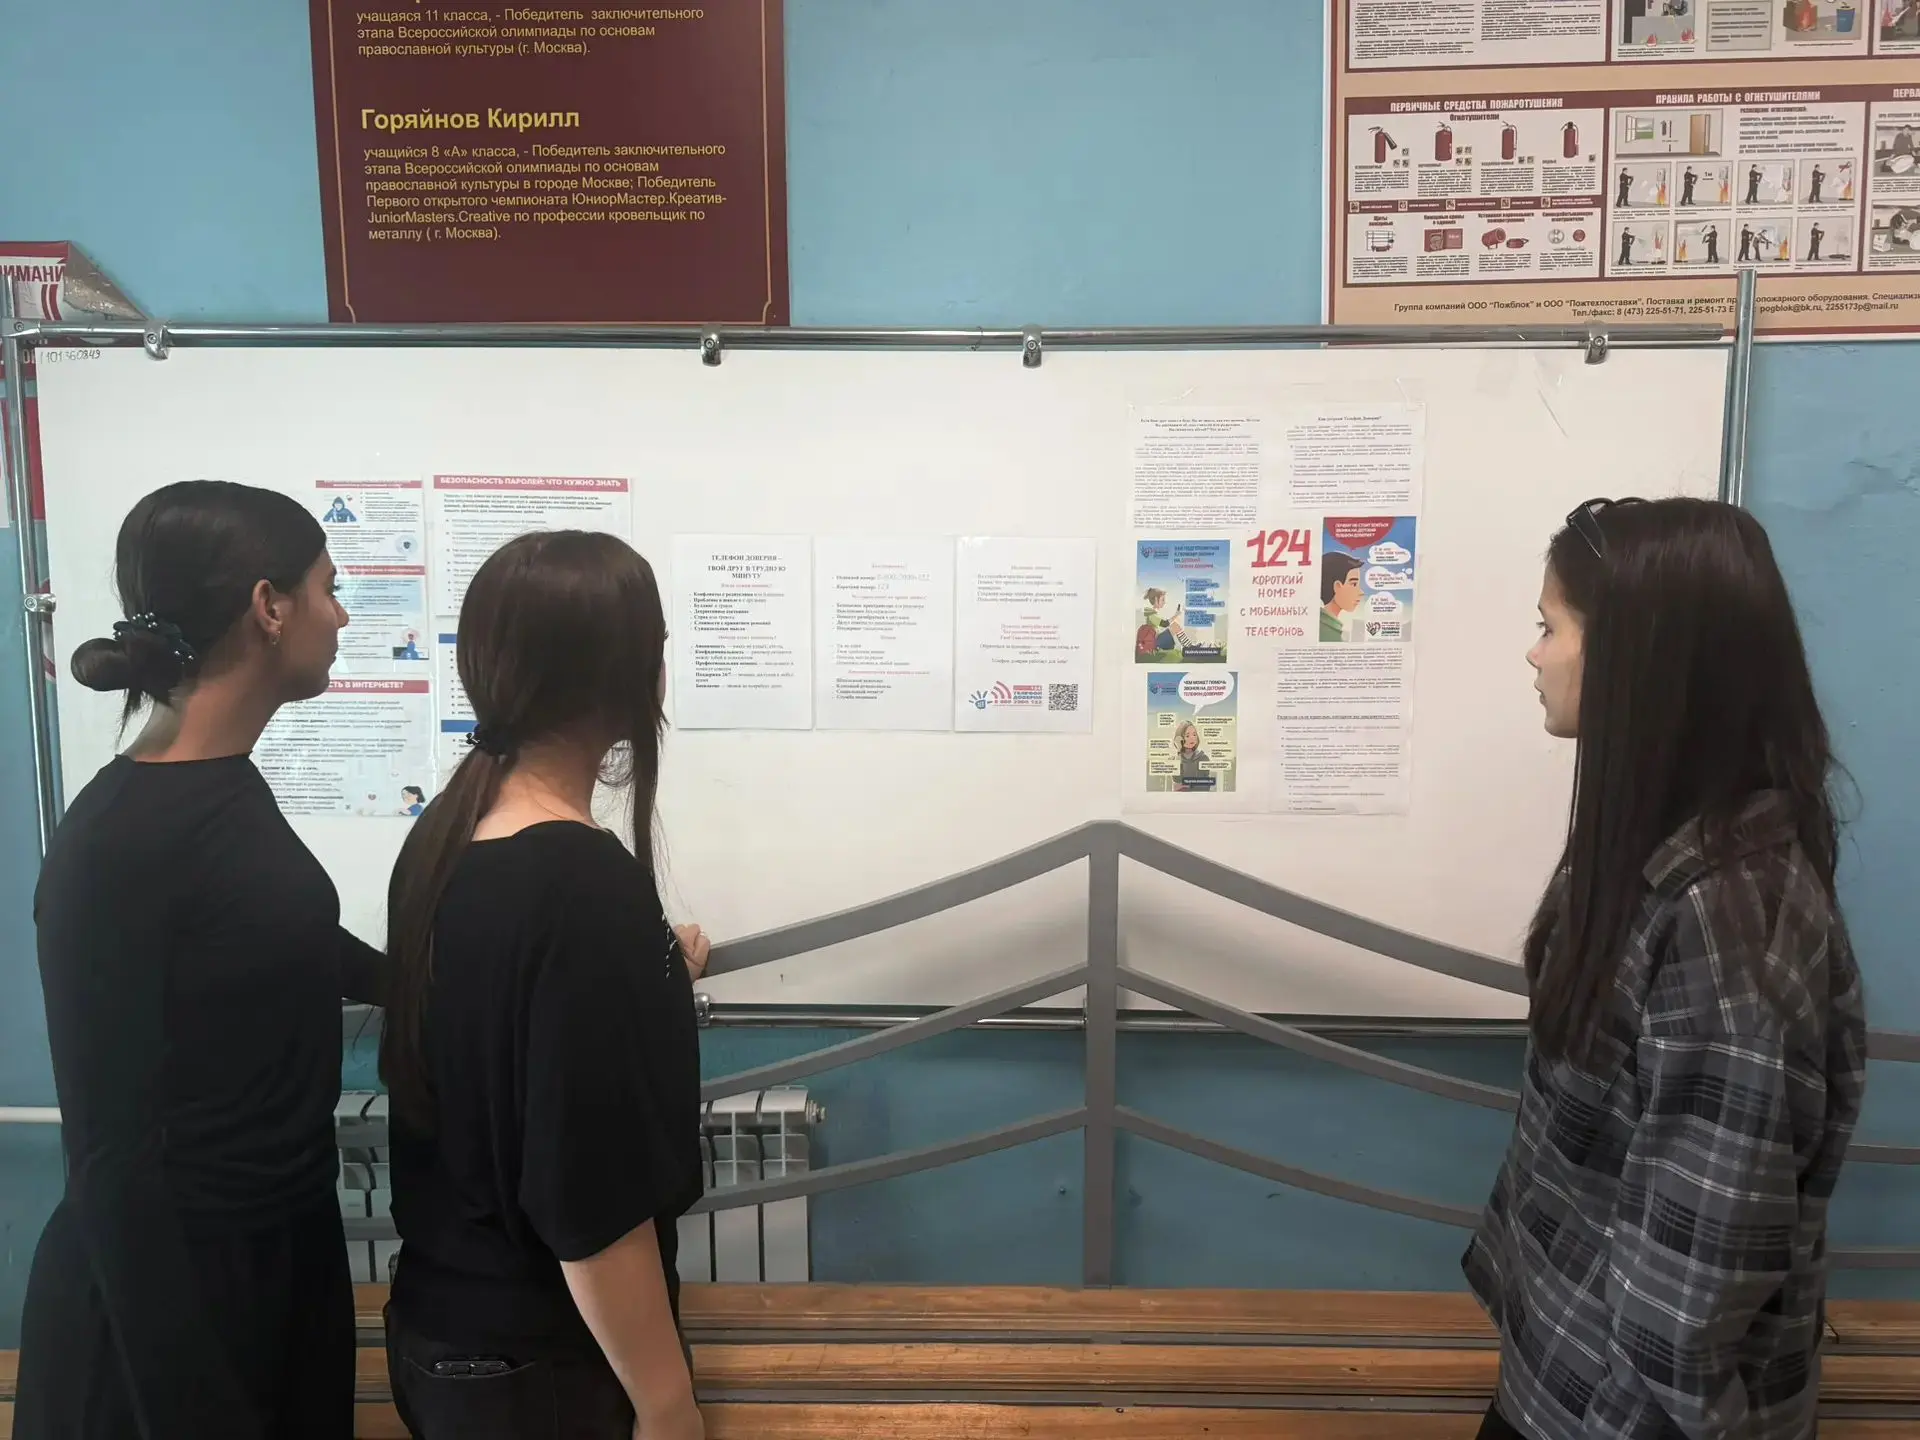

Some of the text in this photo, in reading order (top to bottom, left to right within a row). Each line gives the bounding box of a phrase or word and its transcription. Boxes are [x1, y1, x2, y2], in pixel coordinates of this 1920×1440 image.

[357, 11, 421, 24] учащаяся
[425, 9, 439, 21] 11
[444, 11, 492, 23] класса,
[505, 8, 584, 22] Победитель
[591, 8, 704, 20] заключительного
[357, 25, 655, 40] этапа Всероссийской олимпиады по основам
[358, 41, 591, 57] православной культуры (г. Москва).
[1390, 97, 1563, 113] ПЕРВИЧНЫЕ СРЕДСТВА ПОЖАРОТУШЕНИЯ
[1656, 90, 1821, 105] ПРАВИЛА РАБОТЫ С ОГНЕТУШИТЕЛЯМИ
[361, 107, 580, 134] Горяйнов Кирилл
[1450, 112, 1500, 122] Огнетушители
[364, 146, 428, 161] учащийся
[431, 145, 440, 157] 8
[443, 145, 467, 157] «А»
[472, 146, 520, 159] класса,
[532, 144, 610, 158] Победитель
[614, 144, 726, 156] заключительного
[364, 161, 659, 177] этапа Всероссийской олимпиады по основам
[366, 175, 716, 193] православной культуры в городе Москве; Победитель
[367, 192, 727, 209] Первого открытого чемпионата ЮниорМастер.Креатив-
[368, 209, 705, 224] JuniorMasters.Creative по профессии кровельщик по
[368, 229, 422, 242] металлу
[434, 229, 442, 240] г.
[445, 226, 501, 241] Москва).
[1394, 303, 1423, 312] Группа
[1425, 302, 1466, 311] компаний
[1467, 302, 1487, 310] ООО
[1543, 300, 1563, 308] ООО
[1646, 297, 1685, 305] Поставка
[1694, 297, 1724, 305] ремонт
[1807, 293, 1870, 302] оборудования.
[1572, 308, 1614, 317] Тел./факс:
[1617, 308, 1623, 316] 8
[1624, 308, 1644, 317] (473)
[1645, 306, 1687, 315] 225-51-71,
[1688, 305, 1733, 314] 225-51-73
[1760, 302, 1822, 314] pogblok@bk.ru,
[1825, 302, 1899, 312] 2255173p@mail.ru
[440, 476, 621, 488] БЕЗОПАСНОСТЬ ПАРОЛЕЙ: ЧТО НУЖНО ЗНАТЬ
[1247, 529, 1312, 568] 124
[1252, 572, 1304, 586] КОРОТКИЙ
[1258, 588, 1296, 598] НОМЕР
[1249, 606, 1308, 616] МОБИЛЬНЫХ
[1245, 626, 1304, 637] ТЕЛЕФОНОВ
[352, 681, 404, 689] ИНТЕРНЕТЕ?
